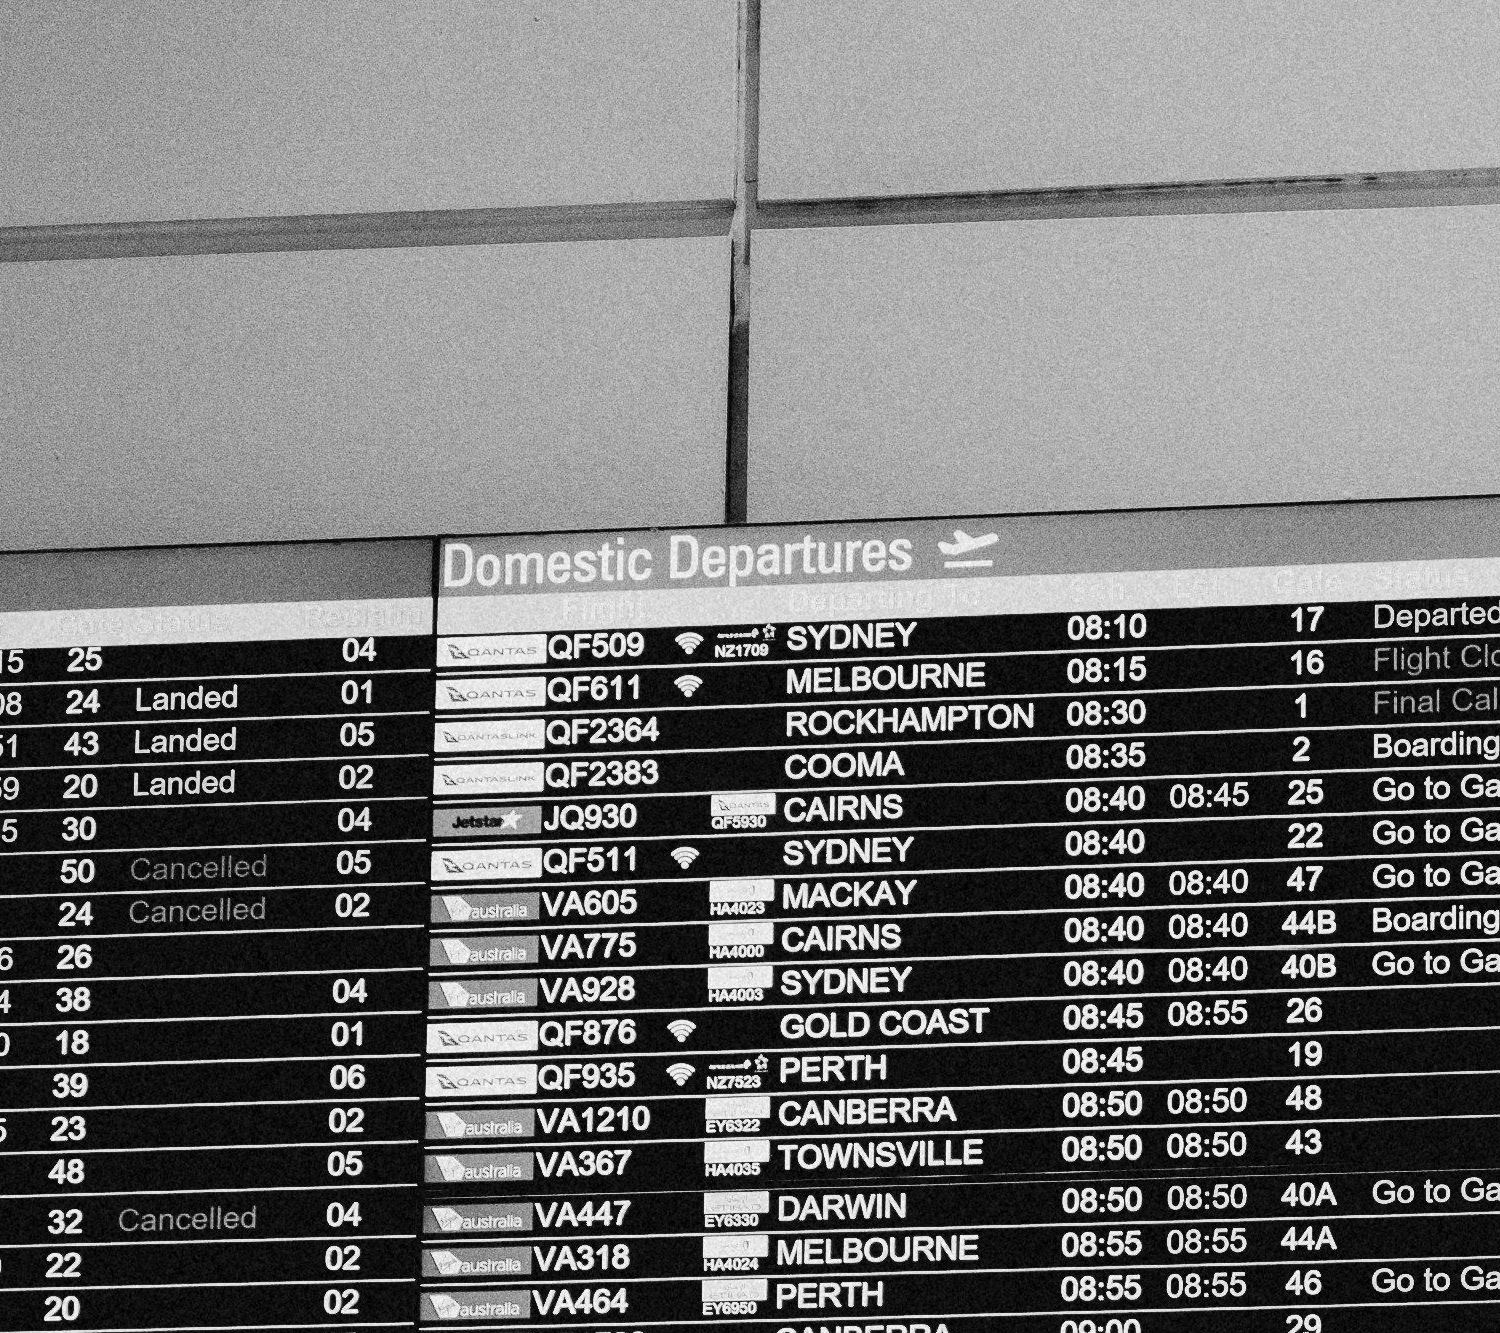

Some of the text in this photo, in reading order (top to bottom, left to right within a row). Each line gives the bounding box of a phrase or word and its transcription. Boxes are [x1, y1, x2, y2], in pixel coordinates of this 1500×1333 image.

[445, 534, 912, 587] Domestic Departures
[67, 646, 102, 672] 25
[341, 638, 376, 662] 04
[547, 674, 639, 702] QF611
[787, 662, 985, 694] MELBOURNE
[1067, 656, 1146, 683] 08:15
[1291, 649, 1324, 675] 16
[1374, 646, 1450, 676] Flight
[66, 689, 100, 714] 24
[136, 684, 237, 711] Landed
[341, 680, 372, 704] 01
[544, 803, 637, 830] JQ930
[711, 815, 767, 829] QF5930
[784, 794, 903, 822] CAIRNS
[1066, 785, 1145, 813] 08:40
[1170, 782, 1249, 808] 08:45
[1288, 779, 1324, 805] 25
[1373, 777, 1414, 801] Go
[1424, 776, 1450, 800] to
[60, 859, 95, 883] 50
[131, 854, 266, 881] Cancelled
[337, 850, 371, 874] 05
[56, 1030, 89, 1055] 18
[331, 1021, 362, 1046] 01
[539, 1019, 636, 1047] QF876
[780, 1011, 870, 1039] GOLD
[879, 1007, 990, 1036] COAST
[1063, 1003, 1144, 1030] 08:45
[1168, 999, 1248, 1026] 08:55
[1286, 997, 1322, 1023] 26
[534, 1200, 631, 1228] VA447
[704, 1213, 759, 1227] EY6330
[778, 1193, 906, 1221] DARWIN
[1062, 1186, 1142, 1213] 08:50
[1167, 1184, 1247, 1210] 08:50
[1281, 1182, 1337, 1207] 40A
[1372, 1180, 1414, 1204] Go
[1424, 1179, 1450, 1203] to
[45, 1252, 81, 1278] 22
[325, 1245, 360, 1270] 02
